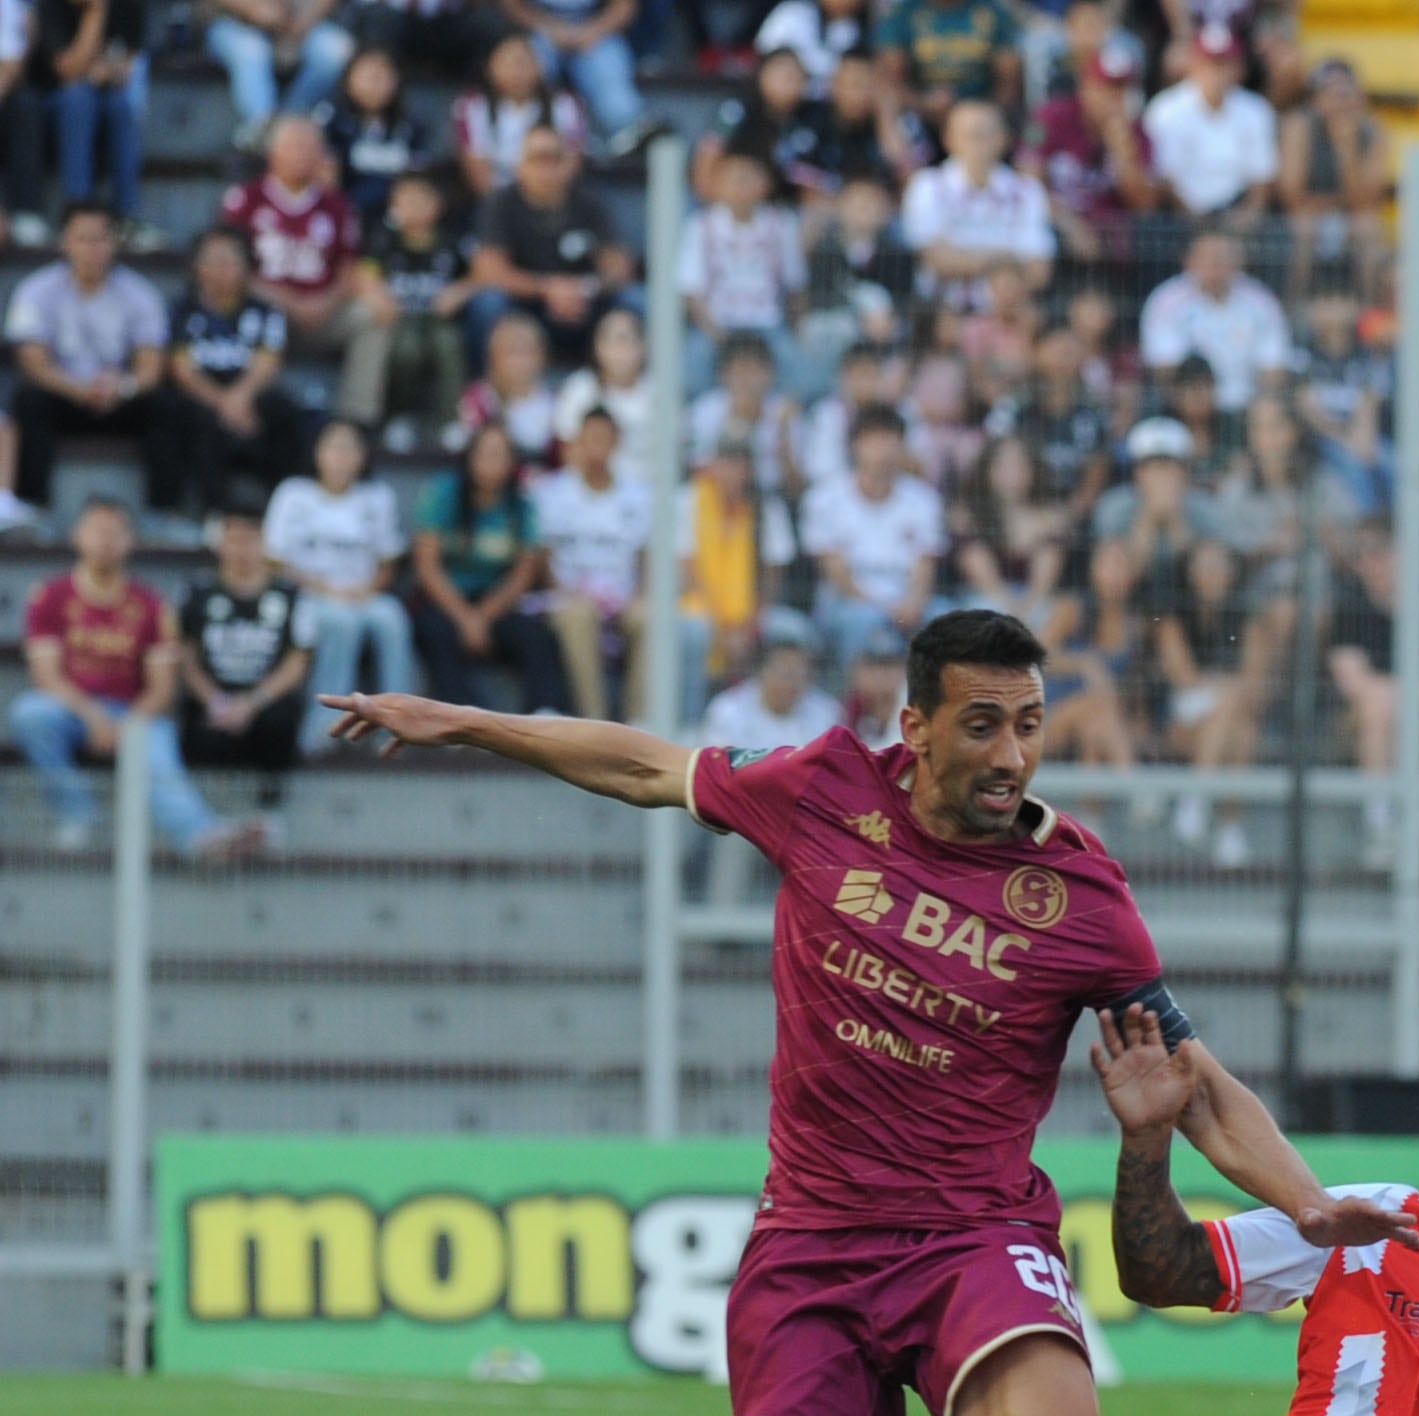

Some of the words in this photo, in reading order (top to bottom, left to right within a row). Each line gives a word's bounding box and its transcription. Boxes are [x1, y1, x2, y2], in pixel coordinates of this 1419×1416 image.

[901, 891, 1032, 982] BAC
[822, 940, 1002, 1034] LIBERTY
[835, 1018, 955, 1073] OMNILIFE
[188, 1192, 760, 1382] mong
